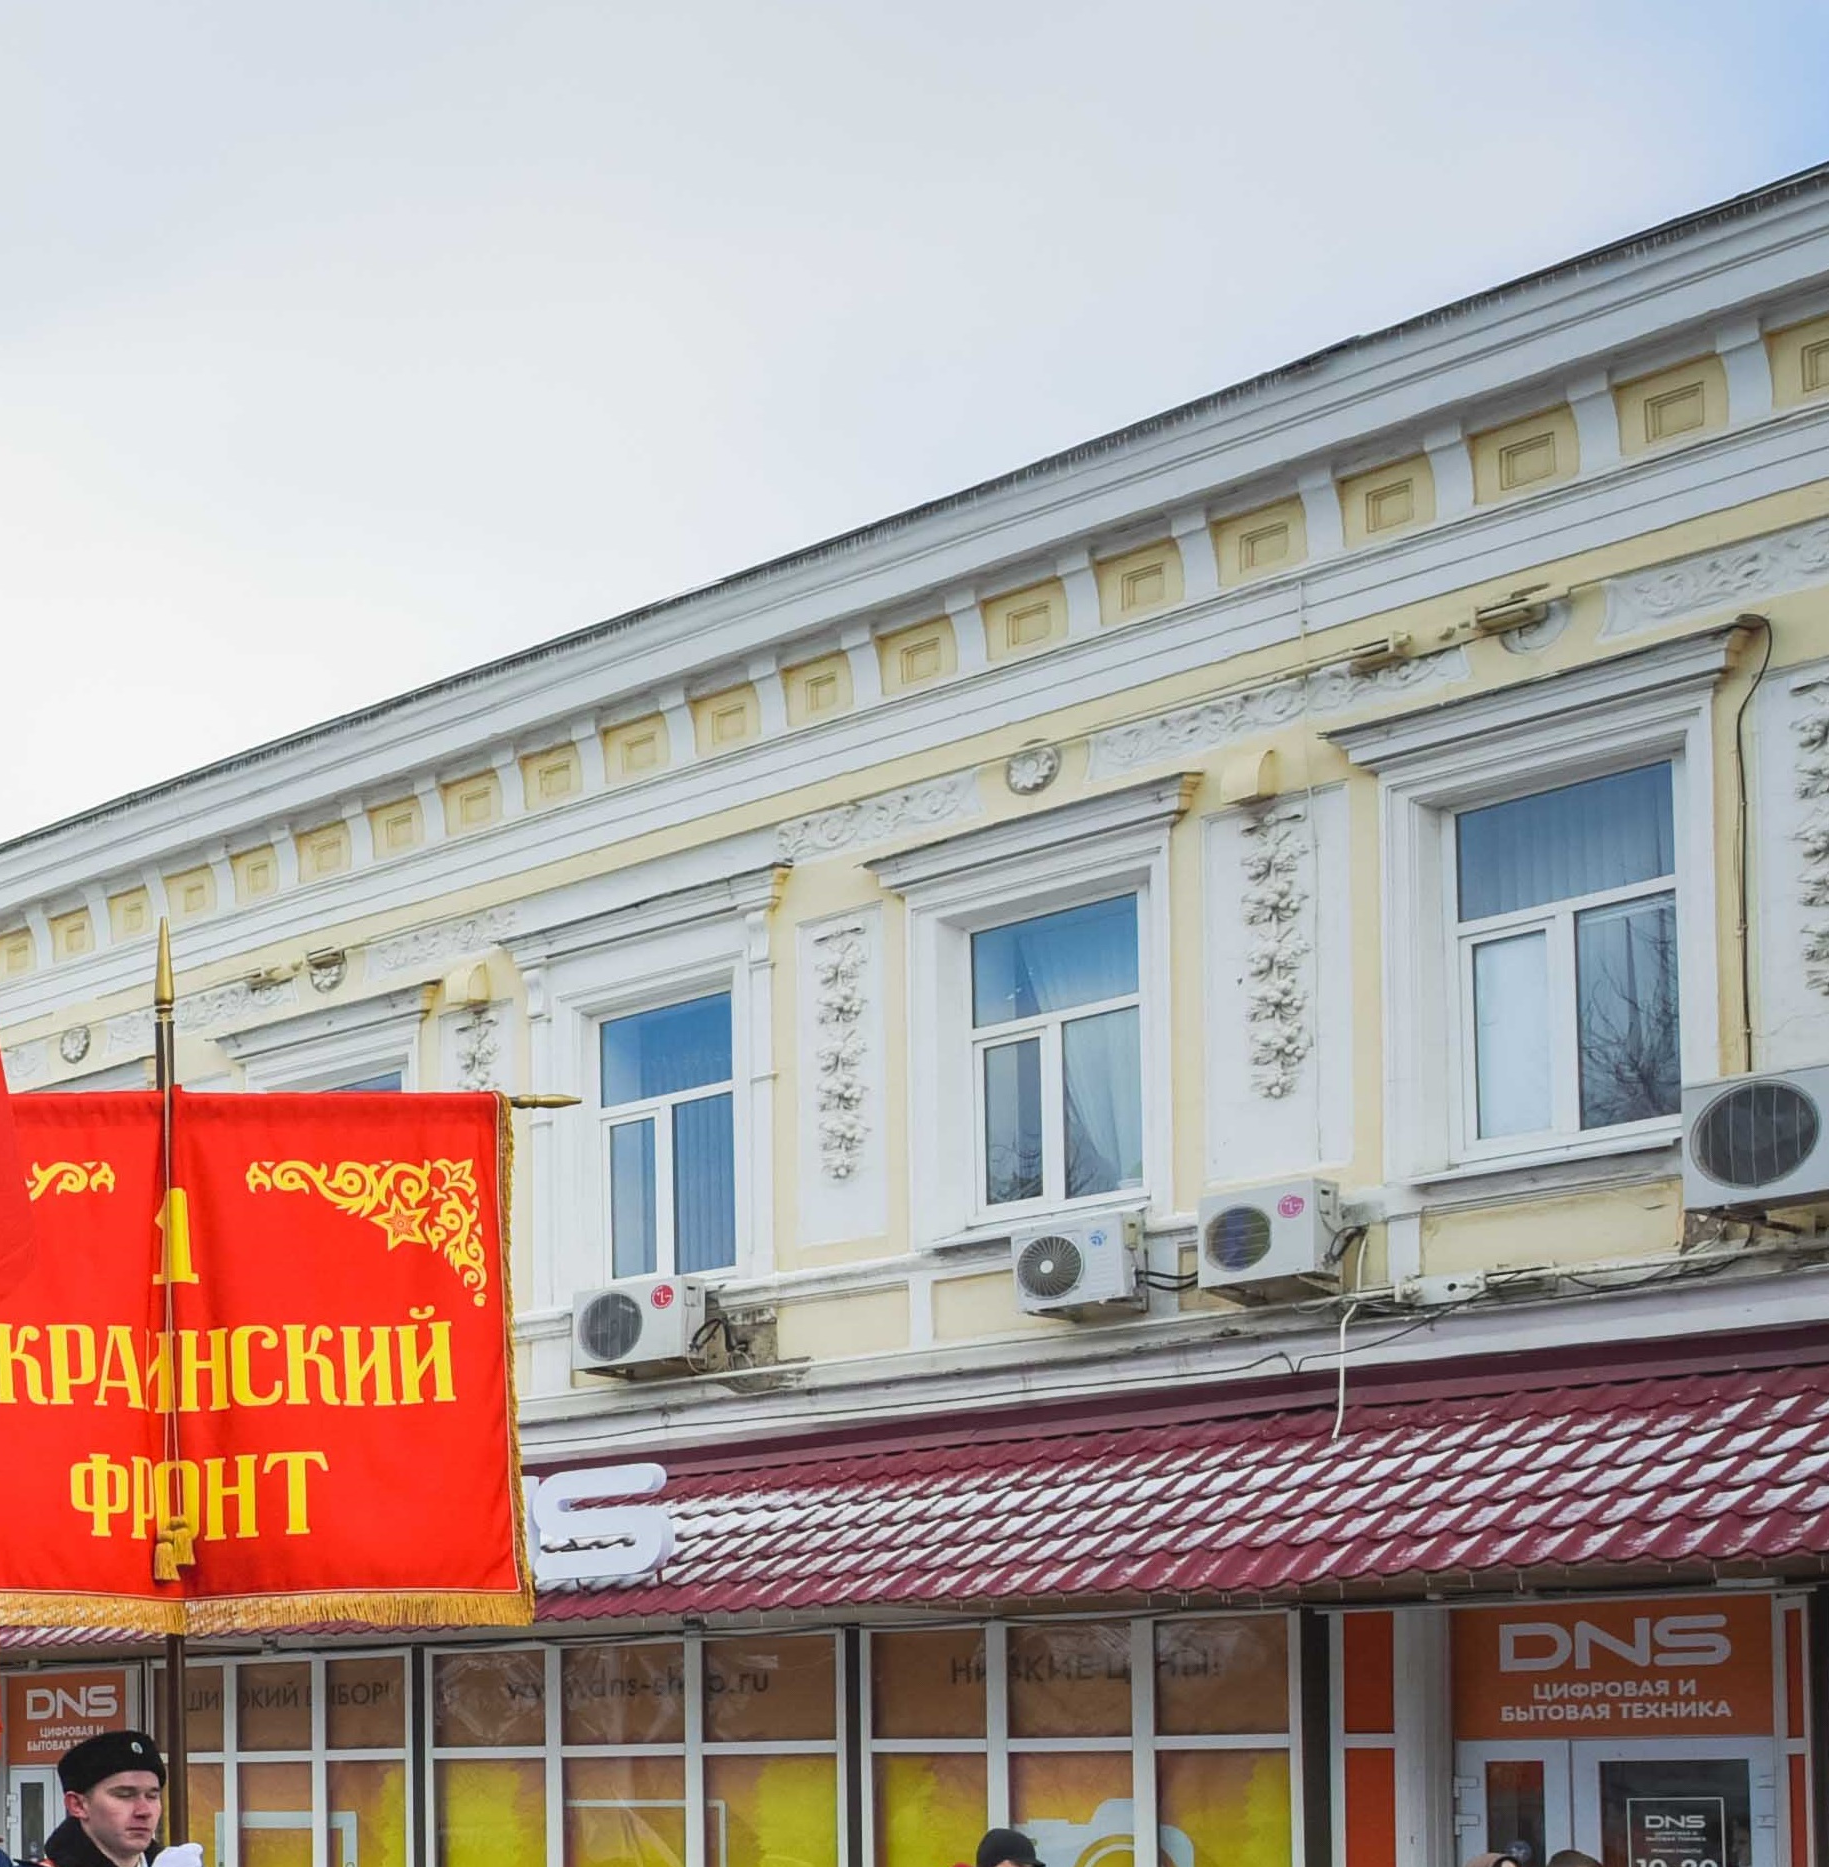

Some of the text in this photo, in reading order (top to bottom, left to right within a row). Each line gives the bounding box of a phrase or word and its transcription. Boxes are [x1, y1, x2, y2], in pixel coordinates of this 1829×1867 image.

[152, 1186, 199, 1286] 1
[69, 1450, 330, 1542] ФРОНТ
[1499, 1614, 1732, 1672] DNS
[1533, 1679, 1697, 1701] ЦИФРОВАЯ И
[26, 1685, 118, 1720] DNS
[1500, 1701, 1733, 1722] БЫТОВАЯ ТЕХНИКА
[39, 1725, 94, 1739] ЦИФРОВАЯ
[26, 1739, 72, 1752] БЫТОВАЯ
[1644, 1814, 1706, 1829] DNS
